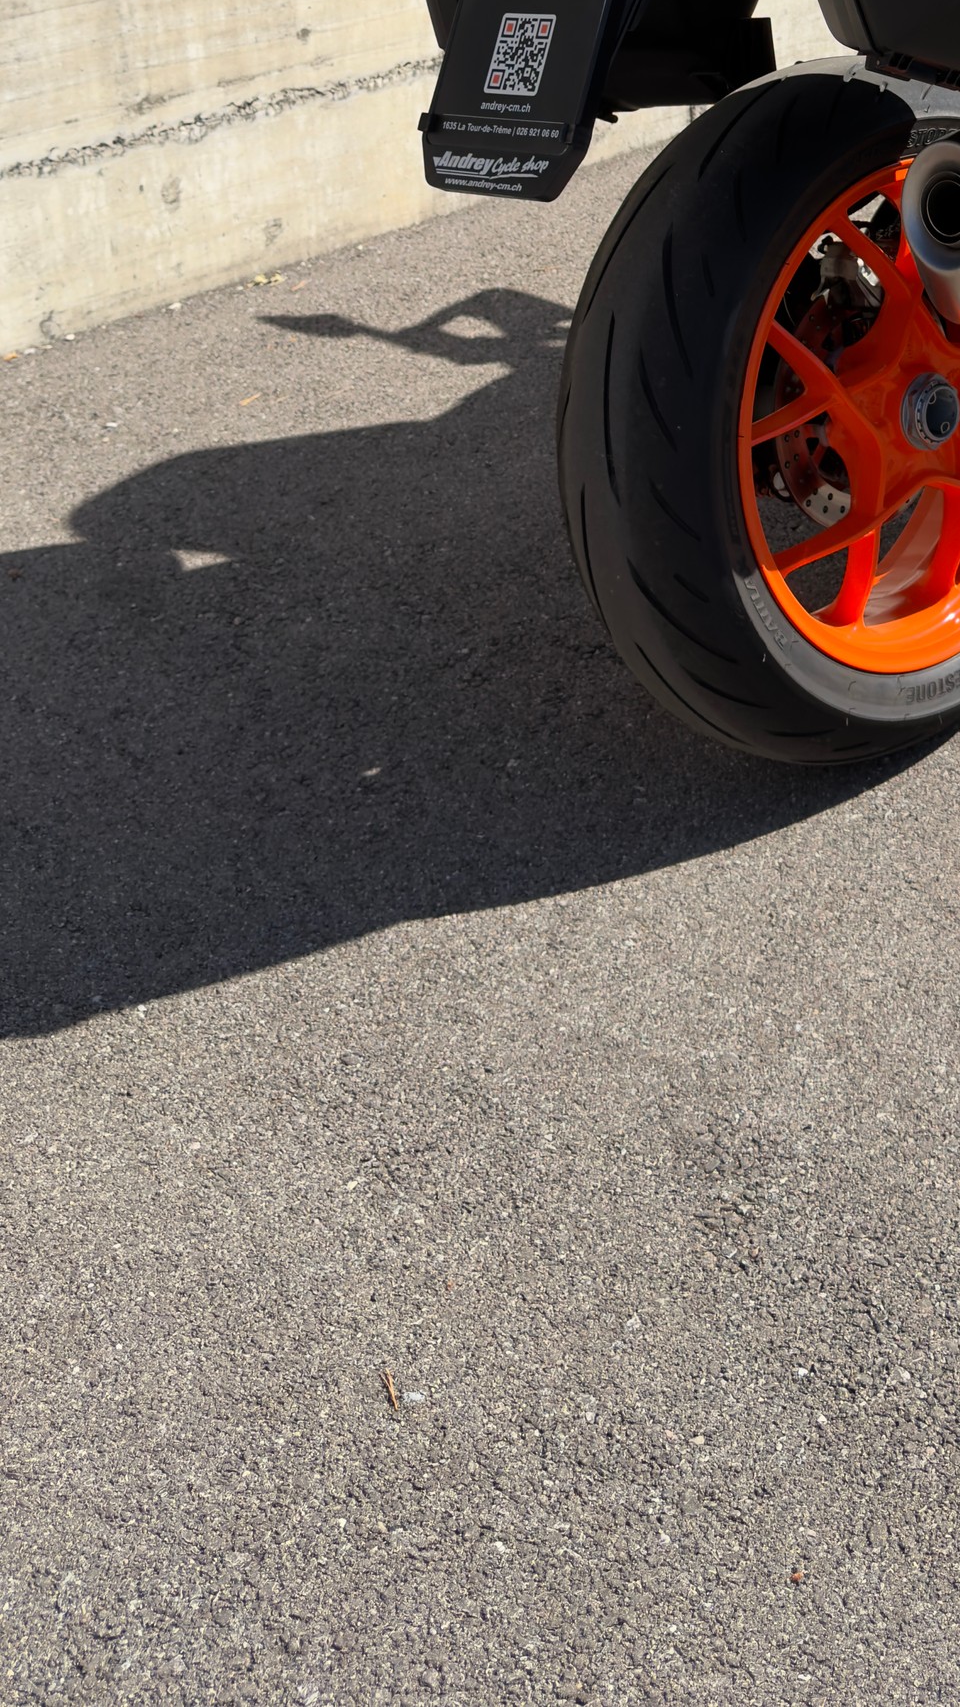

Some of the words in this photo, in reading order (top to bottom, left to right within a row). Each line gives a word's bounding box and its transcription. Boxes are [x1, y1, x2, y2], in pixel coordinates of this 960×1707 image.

[480, 101, 531, 114] andrey-cm.ch
[442, 121, 457, 131] 1635
[457, 122, 466, 131] La
[467, 122, 512, 136] Tour-de-Trême
[516, 126, 528, 137] 026
[528, 127, 541, 137] 921
[550, 128, 560, 139] 60
[438, 150, 494, 175] Andrey
[492, 156, 520, 175] Cycle
[521, 155, 549, 174] shop
[444, 177, 523, 192] www.andrey-cm.ch
